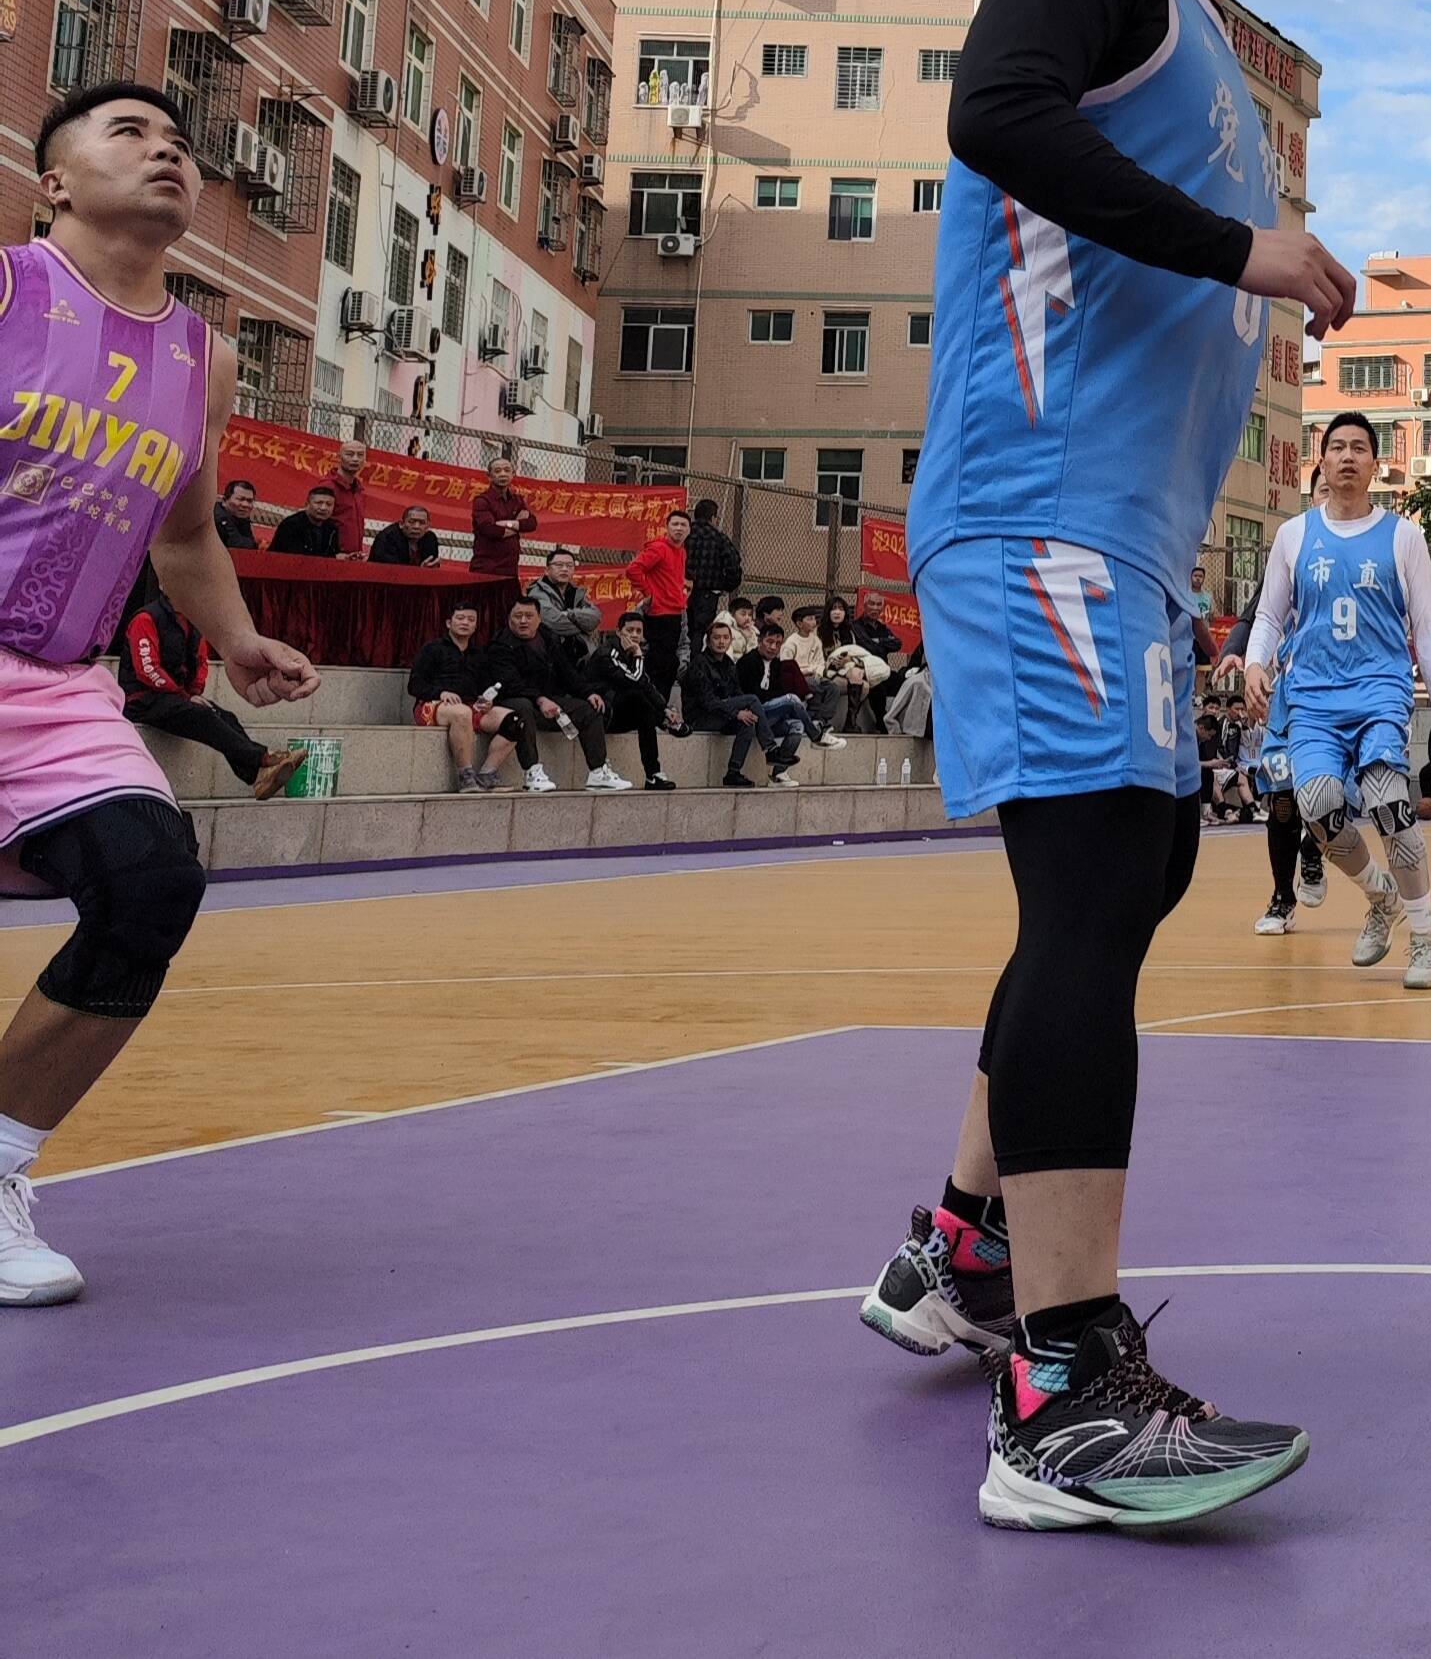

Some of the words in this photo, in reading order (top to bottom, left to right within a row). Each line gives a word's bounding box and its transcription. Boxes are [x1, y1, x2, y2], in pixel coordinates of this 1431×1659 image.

[107, 350, 138, 403] 7
[0, 391, 185, 500] JINYAN
[1307, 557, 1381, 592] 市直
[1331, 596, 1358, 641] 9
[1143, 641, 1177, 751] 6
[1262, 752, 1289, 783] 13
